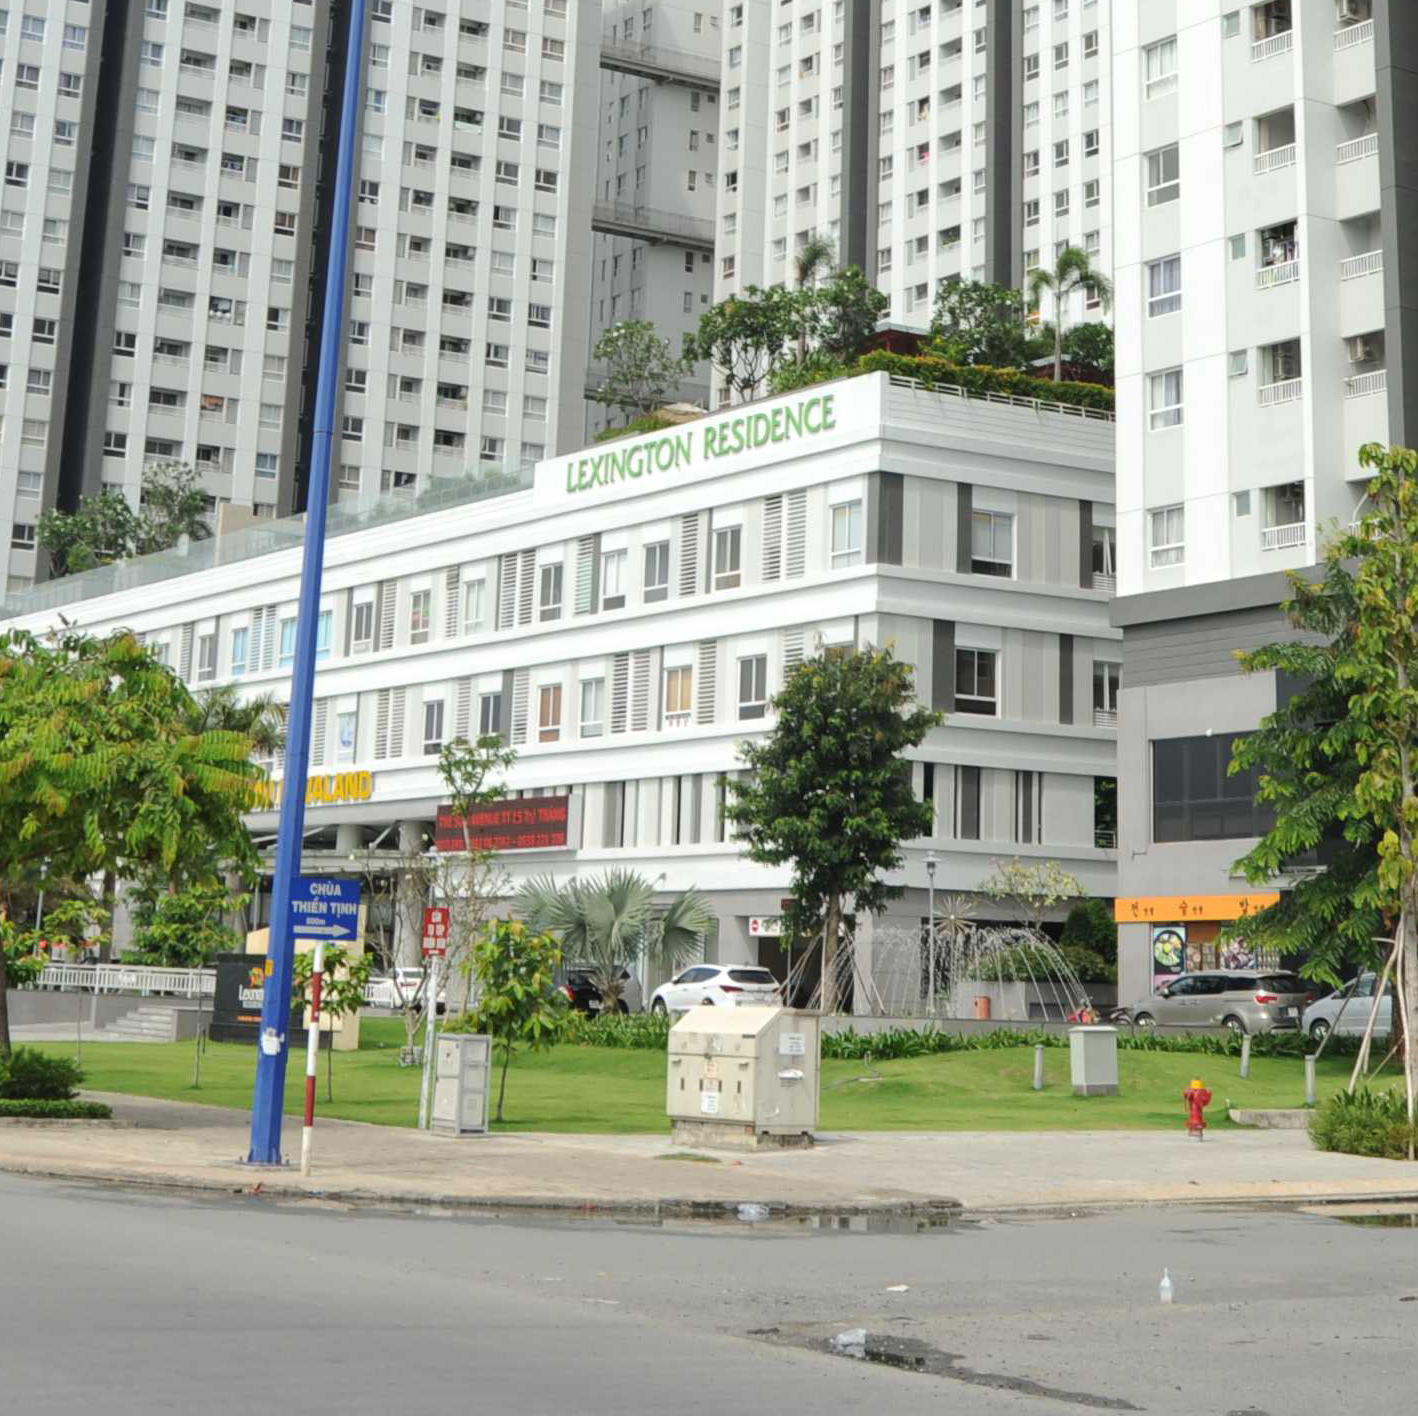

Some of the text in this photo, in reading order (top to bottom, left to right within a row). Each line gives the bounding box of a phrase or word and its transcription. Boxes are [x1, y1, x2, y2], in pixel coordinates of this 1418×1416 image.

[566, 394, 837, 493] LEXINGTON RESIDENCE
[309, 880, 341, 896] CHÙA
[331, 902, 357, 918] TỊNH
